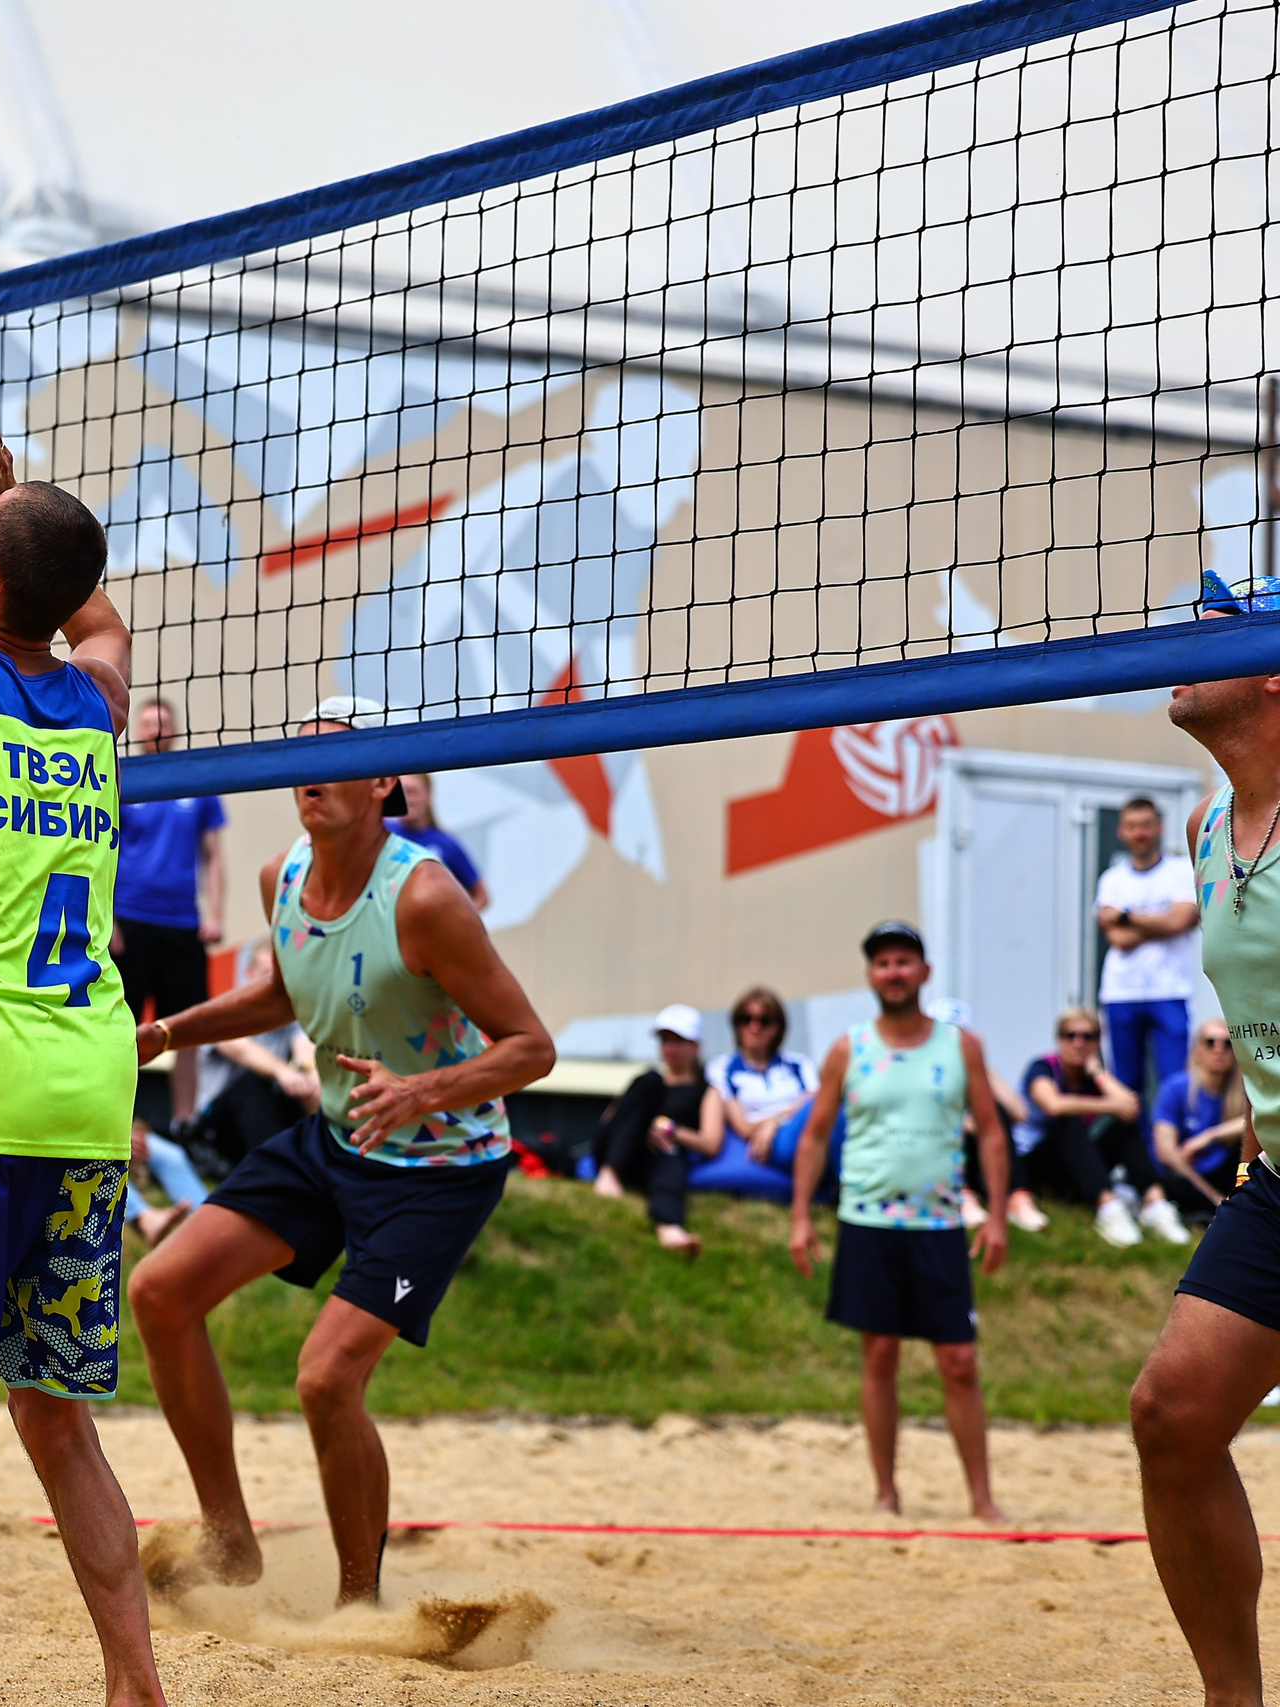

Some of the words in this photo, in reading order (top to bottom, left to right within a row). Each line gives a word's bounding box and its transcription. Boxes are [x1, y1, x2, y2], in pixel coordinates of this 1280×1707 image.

[2, 741, 108, 792] ТВЭЛ-
[26, 872, 102, 1007] 4
[350, 951, 363, 986] 1
